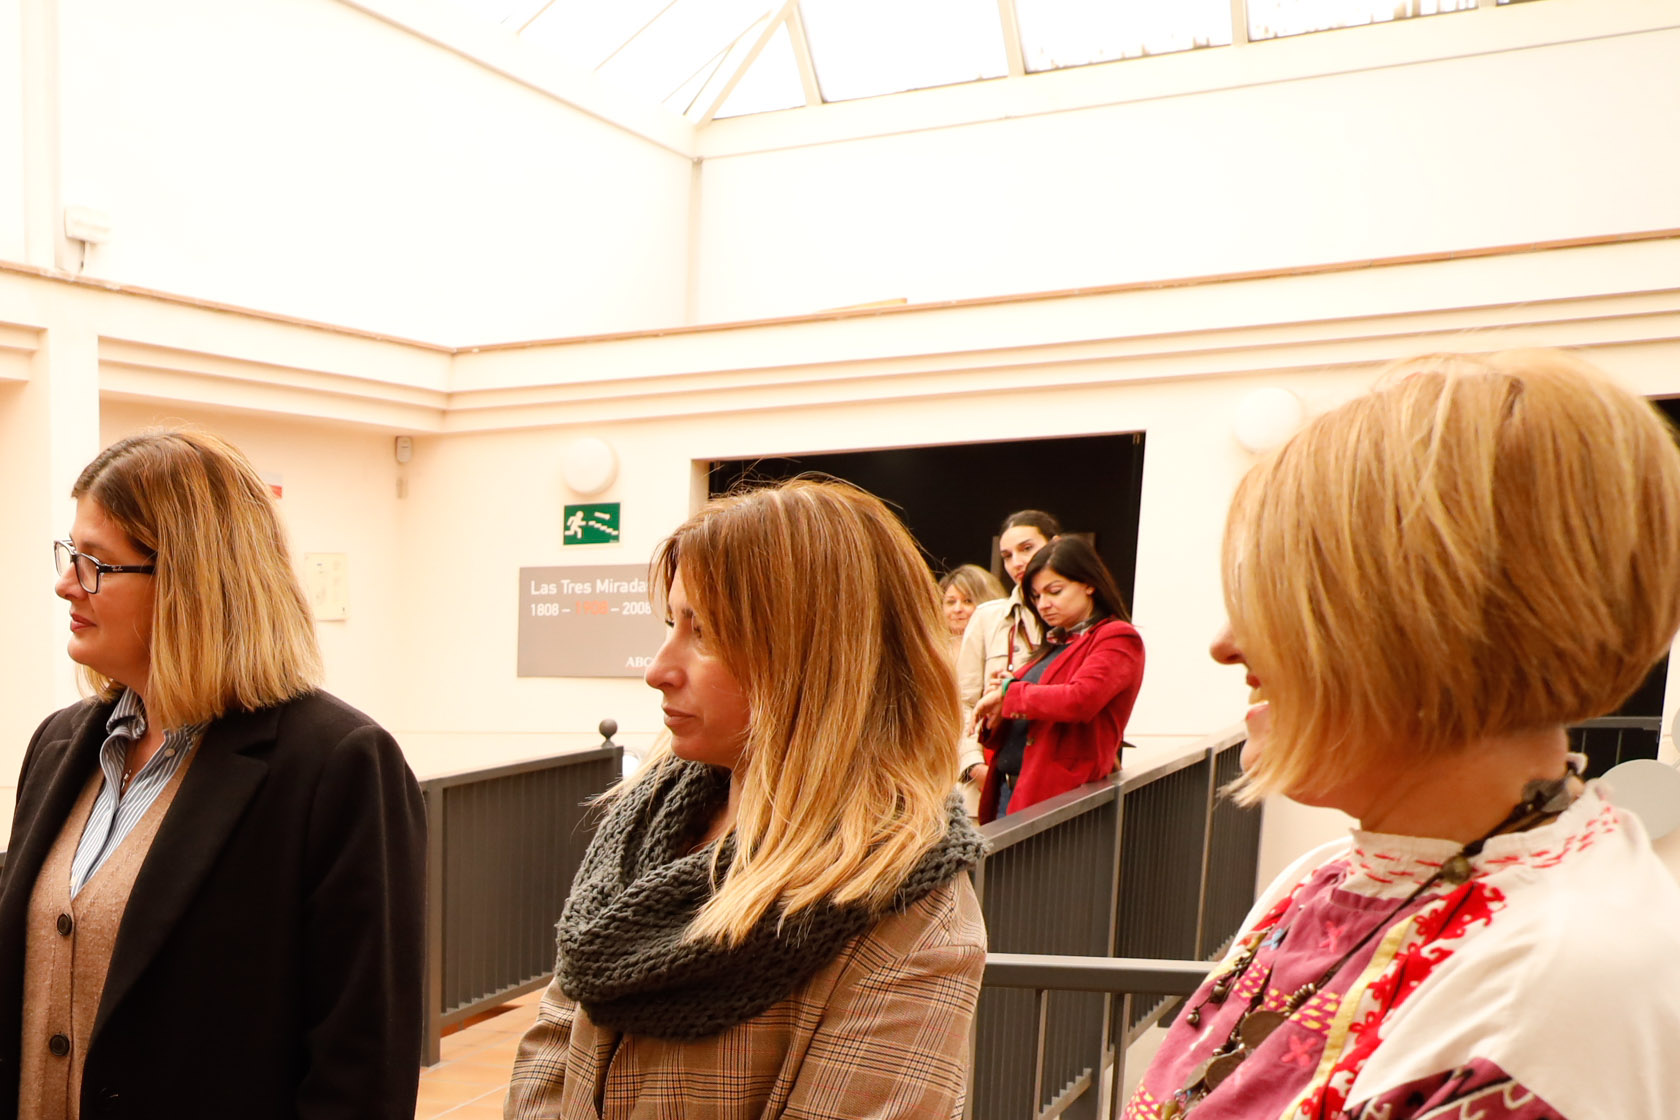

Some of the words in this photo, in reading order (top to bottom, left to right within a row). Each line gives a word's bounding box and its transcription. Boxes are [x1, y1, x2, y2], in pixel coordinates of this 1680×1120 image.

[530, 580, 557, 595] Las
[561, 579, 592, 594] Tres
[596, 578, 648, 593] Mirada
[531, 603, 559, 616] 1808
